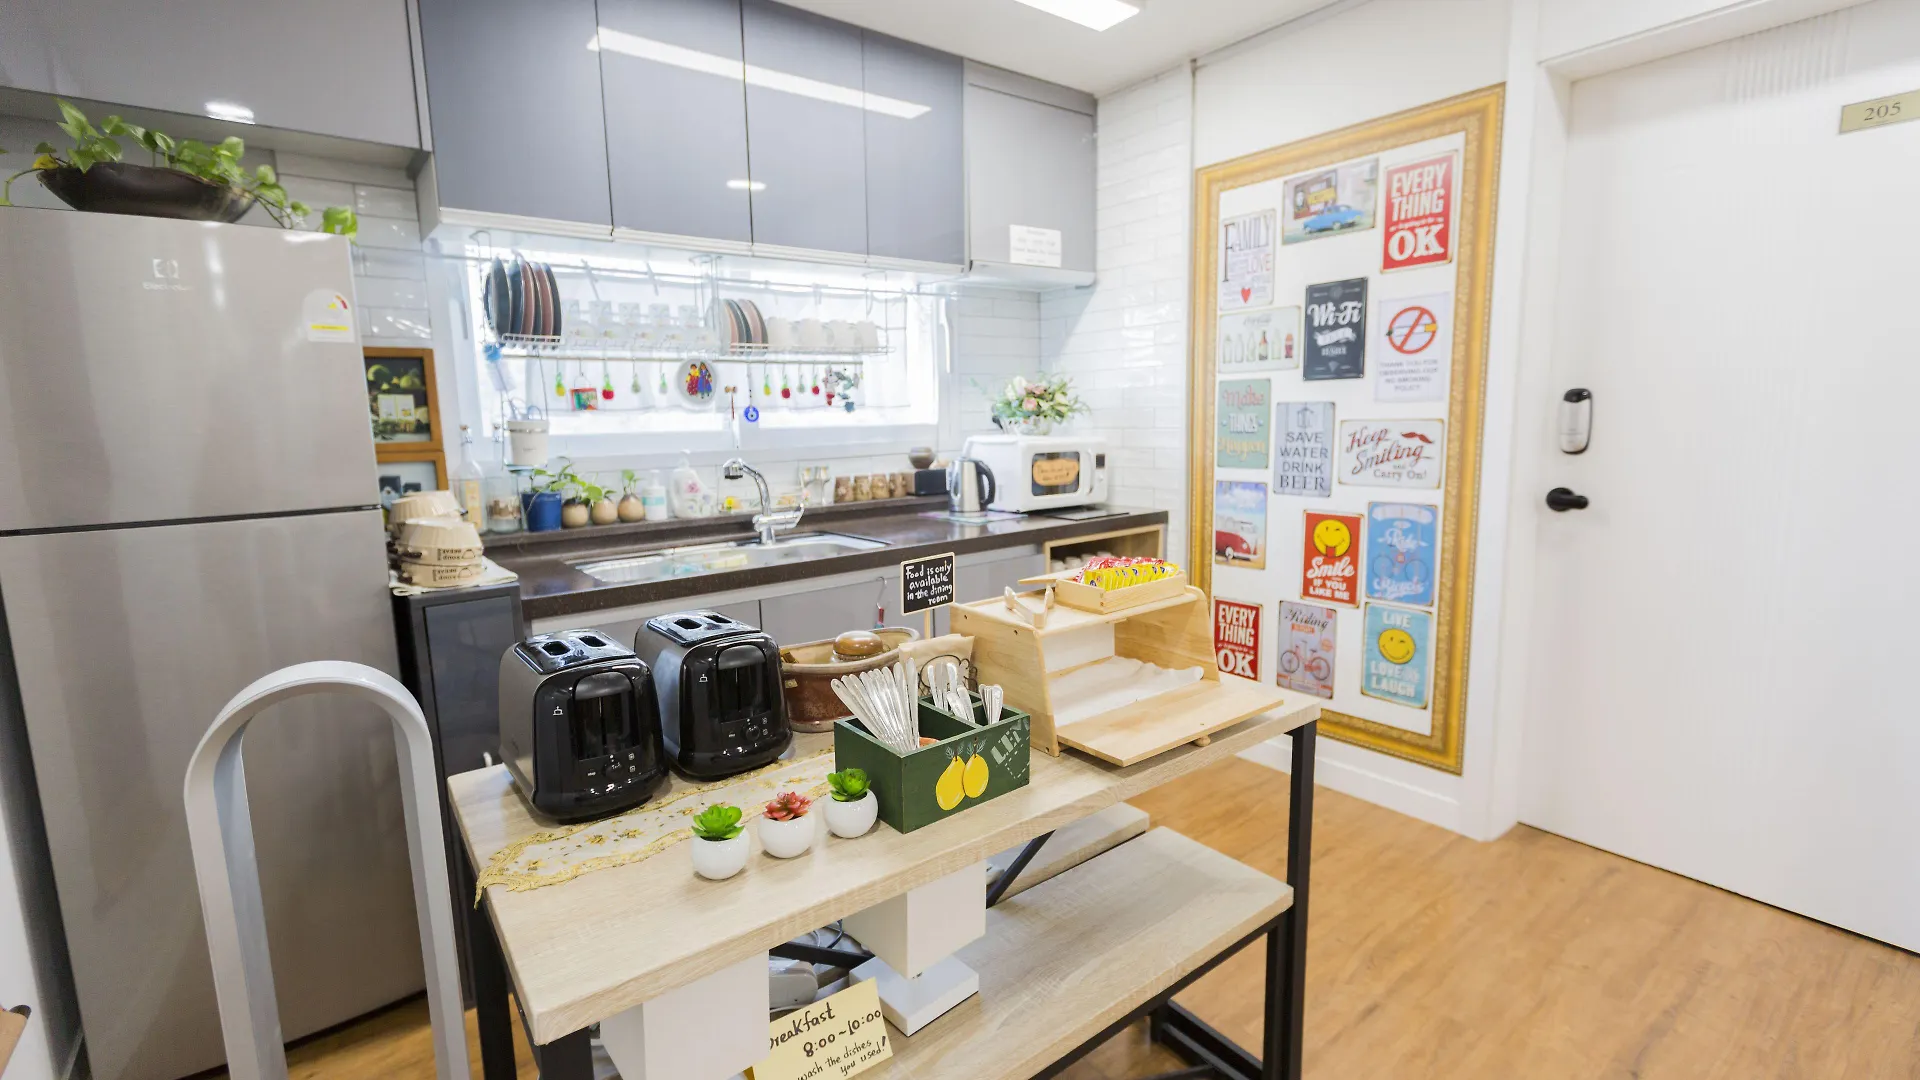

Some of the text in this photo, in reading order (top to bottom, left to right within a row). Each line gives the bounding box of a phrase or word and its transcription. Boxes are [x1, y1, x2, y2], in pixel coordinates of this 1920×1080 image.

[1863, 101, 1901, 121] 205
[1391, 162, 1448, 198] EVERY
[1391, 188, 1445, 222] THING
[1388, 223, 1445, 261] OK
[1286, 432, 1323, 444] SAVE
[1280, 446, 1328, 459] WATER
[1352, 440, 1425, 475] Smiling
[1282, 461, 1324, 474] DRINK
[1373, 469, 1402, 482] Carry
[1280, 474, 1325, 490] BEER
[905, 560, 952, 580] Food is only
[1307, 556, 1355, 579] Smile
[909, 572, 949, 591] available
[1325, 579, 1347, 591] YOU
[907, 584, 953, 600] in the dining
[928, 595, 948, 605] room
[1309, 586, 1350, 600] LIKE ME
[1218, 604, 1257, 629] EVERY
[1218, 622, 1255, 647] THING
[1217, 649, 1255, 678] OK
[797, 1039, 872, 1080] wash the dishes
[840, 1035, 887, 1076] you used!
